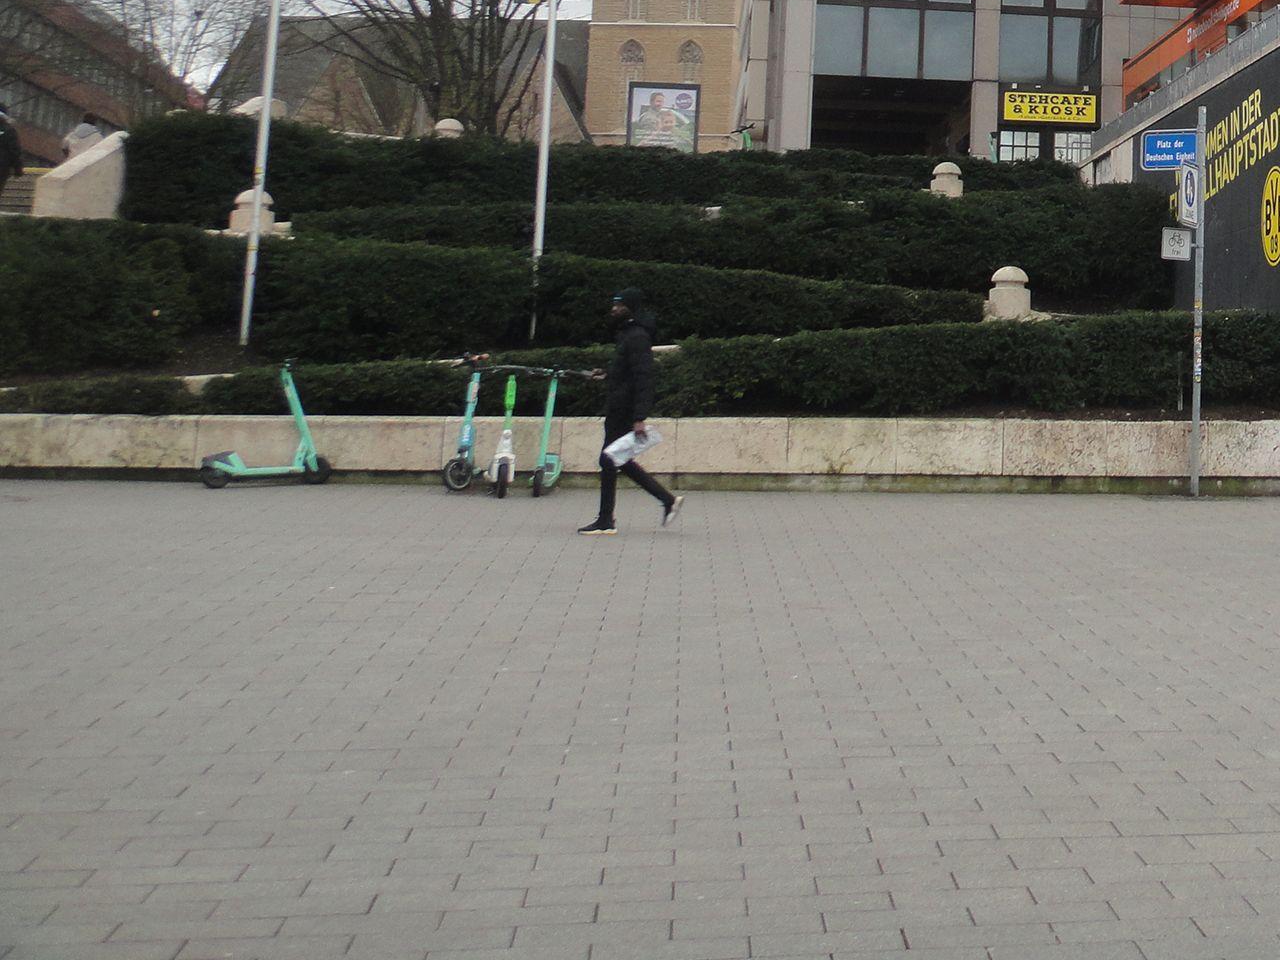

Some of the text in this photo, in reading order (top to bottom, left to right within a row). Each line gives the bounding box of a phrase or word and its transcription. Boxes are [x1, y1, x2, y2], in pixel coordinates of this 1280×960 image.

[1008, 93, 1092, 106] STEHCAFE
[1013, 104, 1086, 116] & KIOSK
[1230, 106, 1240, 139] IN
[1242, 88, 1262, 130] DER
[1156, 139, 1184, 149] Platz der
[1145, 152, 1195, 162] Deutschen Einheit
[1270, 235, 1278, 254] 09
